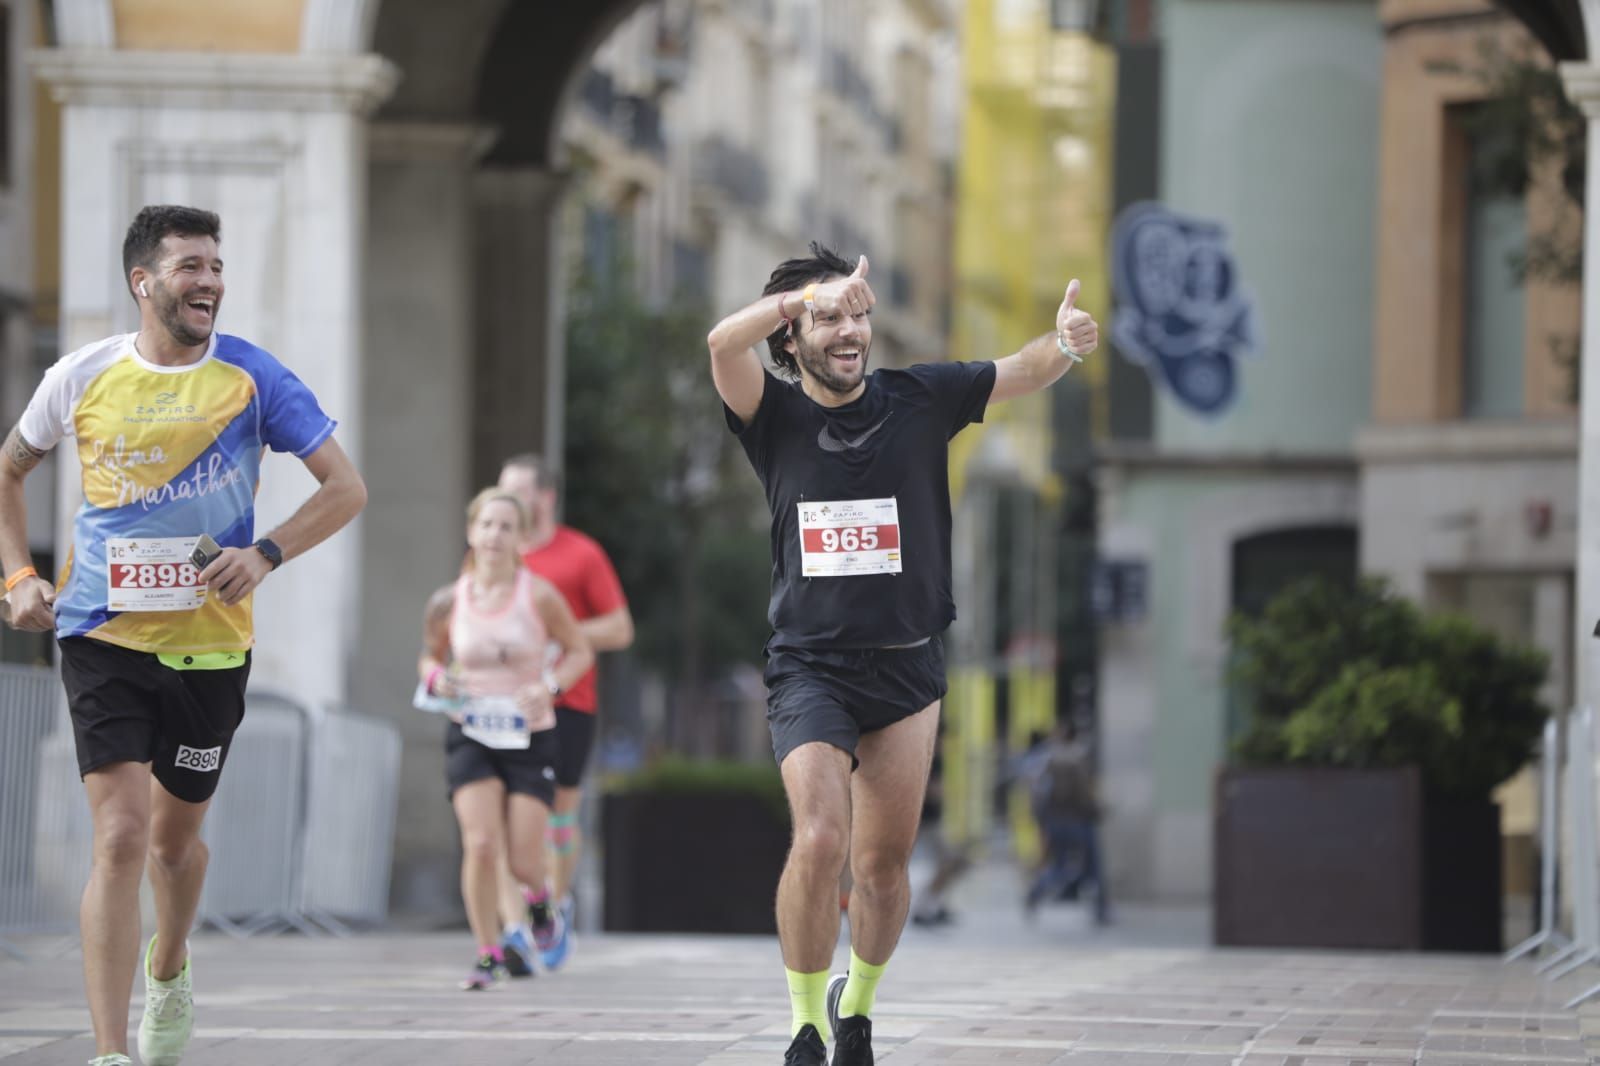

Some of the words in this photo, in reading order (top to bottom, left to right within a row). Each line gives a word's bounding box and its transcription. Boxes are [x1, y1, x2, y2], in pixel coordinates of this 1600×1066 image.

[135, 405, 196, 415] ZAFIRO
[821, 527, 879, 552] 965
[120, 563, 197, 588] 2898
[178, 748, 218, 769] 2898
